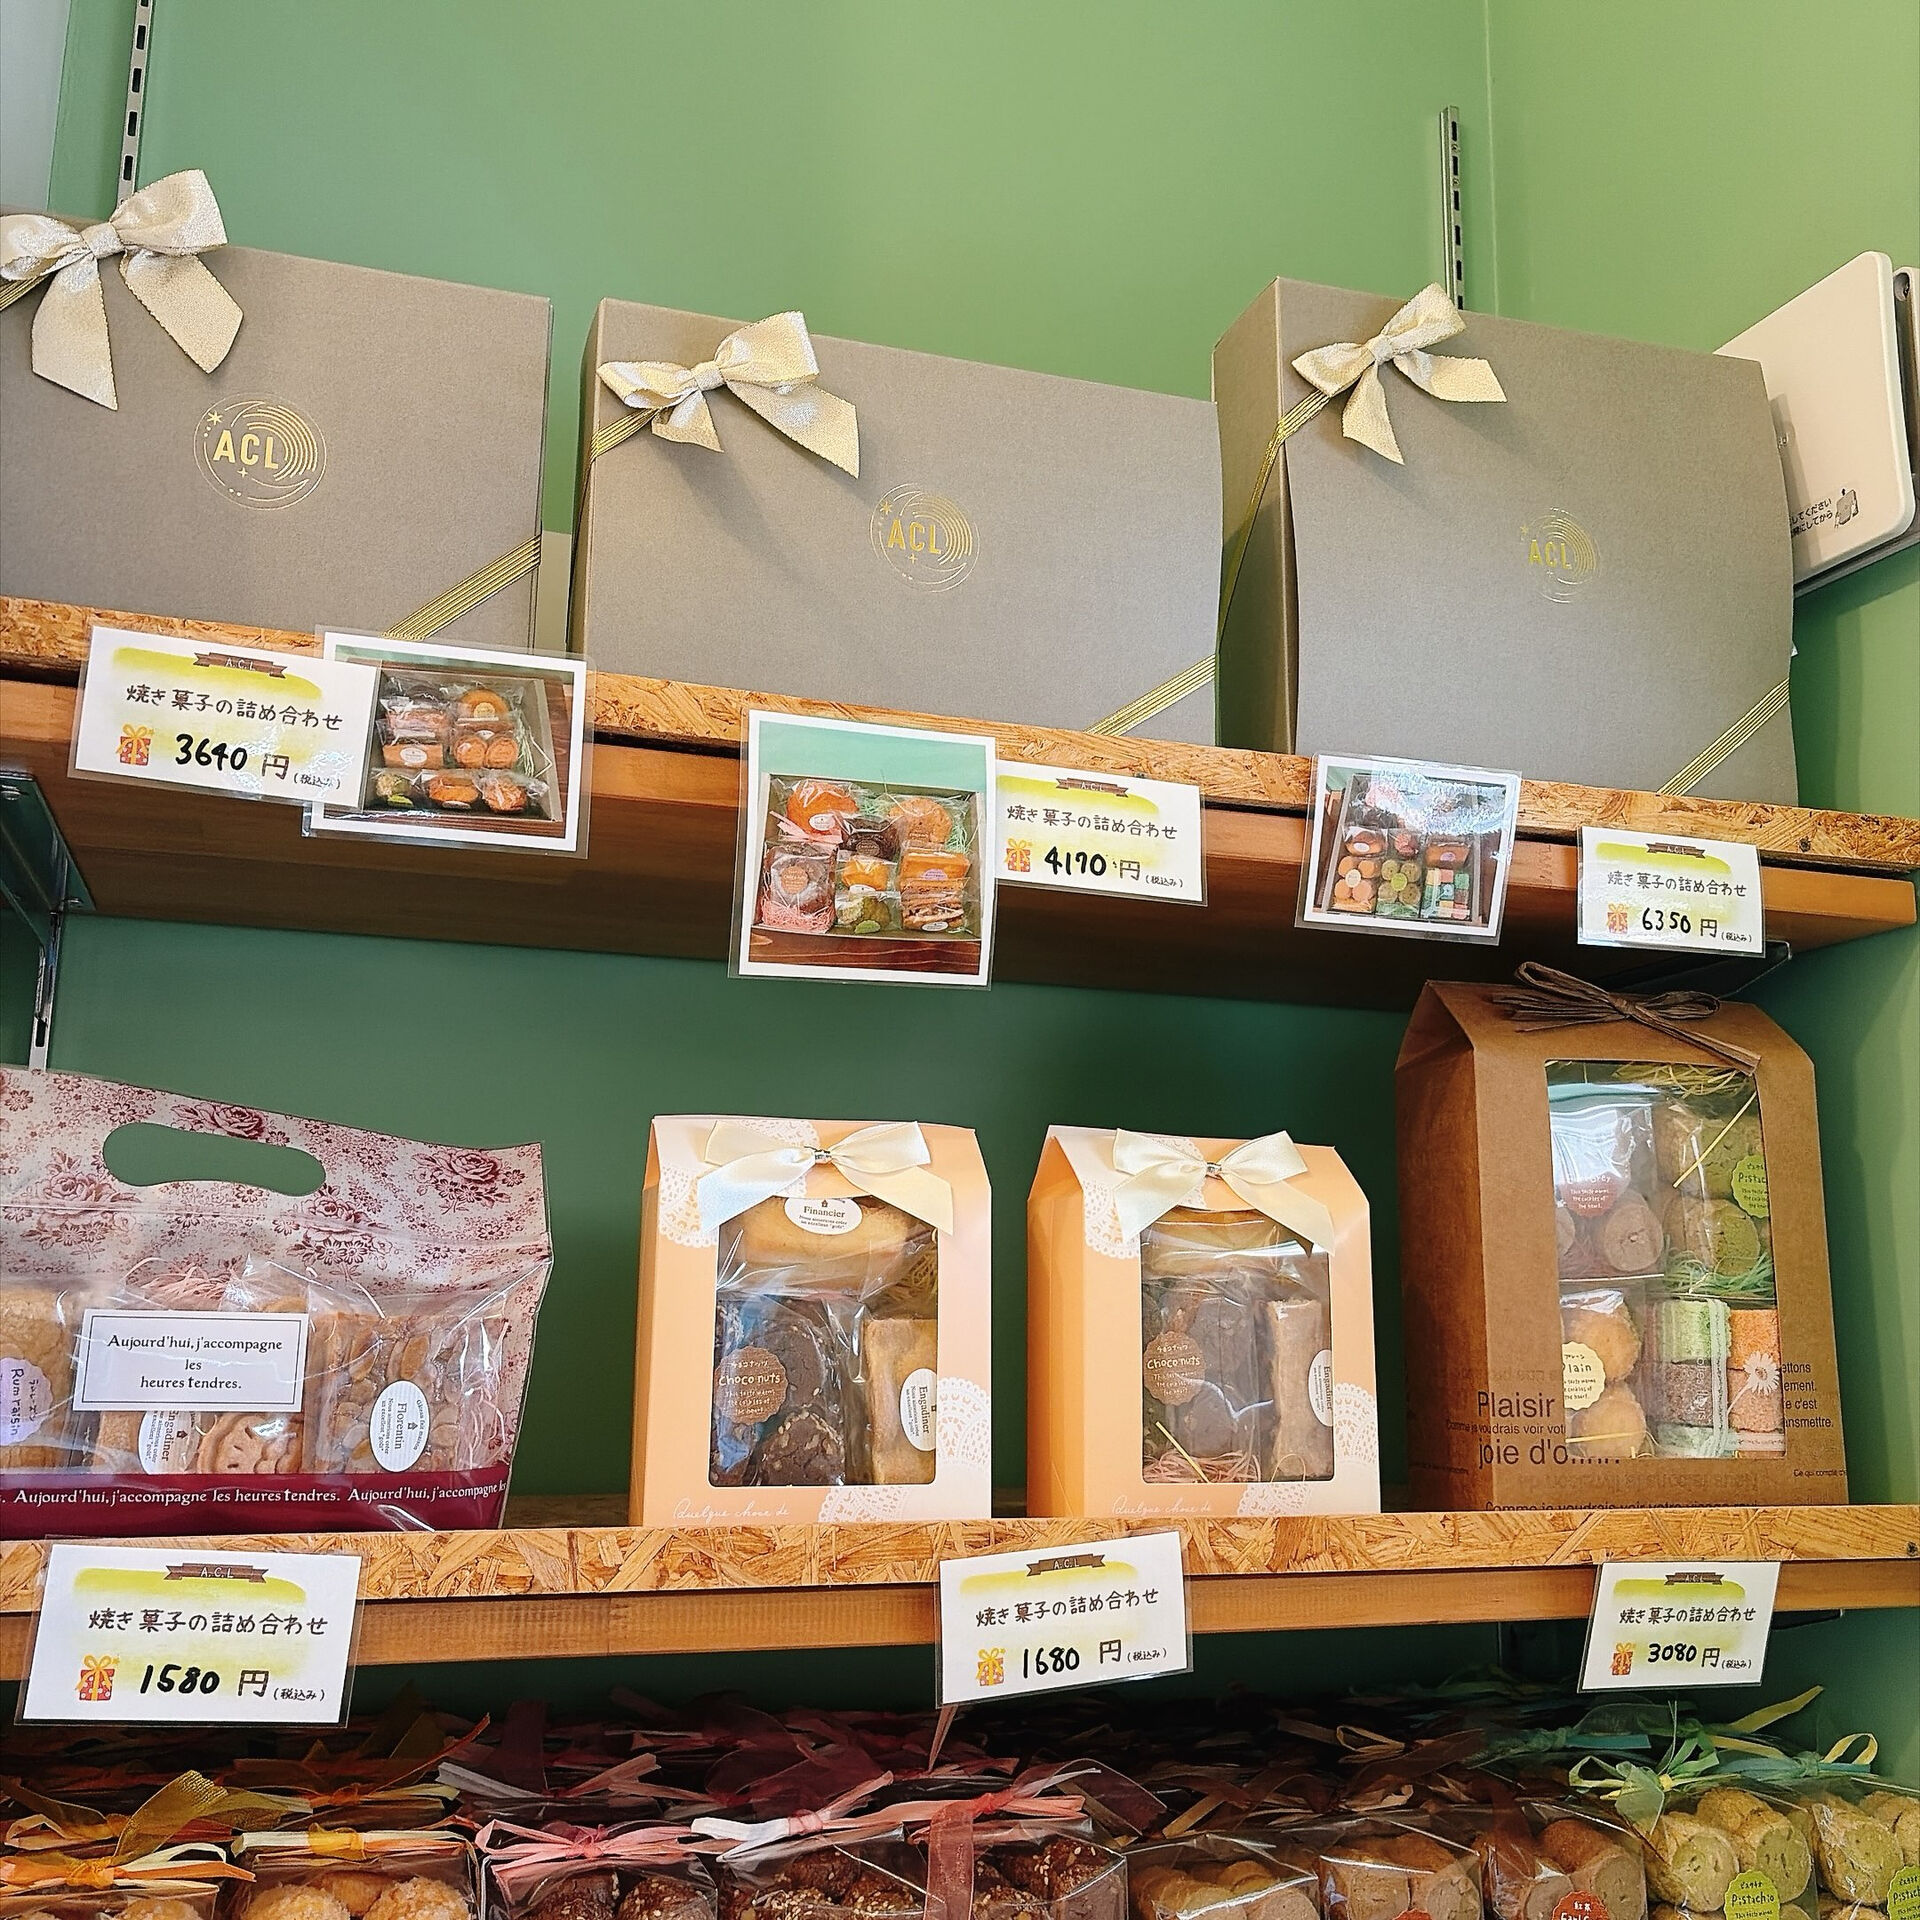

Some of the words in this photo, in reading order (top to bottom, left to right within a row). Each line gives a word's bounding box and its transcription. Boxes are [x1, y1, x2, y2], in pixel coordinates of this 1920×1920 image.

[213, 429, 279, 470] ACL
[888, 518, 942, 556] ACL
[1528, 539, 1573, 570] ACL
[174, 733, 248, 771] 3640
[261, 753, 290, 780] 円
[1044, 846, 1108, 876] 4170
[1119, 859, 1141, 881] 円
[1642, 907, 1692, 934] 6350
[1700, 918, 1718, 938] 円
[803, 1205, 846, 1218] Financier
[185, 1359, 202, 1370] les
[1147, 1359, 1179, 1369] Choco
[1180, 1355, 1201, 1366] nuts
[11, 1368, 25, 1396] Rum
[140, 1376, 185, 1388] heures
[188, 1376, 242, 1389] tendres.
[718, 1375, 755, 1386] Choco
[757, 1372, 781, 1384] nuts
[918, 1386, 930, 1434] Engadiner
[1477, 1391, 1555, 1418] Plaisir
[1795, 1398, 1818, 1410] c'est
[394, 1402, 408, 1450] Florentin
[1479, 1423, 1520, 1434] voudrais
[1523, 1424, 1544, 1434] voir
[1479, 1438, 1519, 1470] joie
[110, 1489, 207, 1507] j'accompagne
[212, 1489, 231, 1502] les
[234, 1488, 281, 1502] heures
[283, 1488, 341, 1502] tendres.
[1022, 1646, 1080, 1678] 1680
[1099, 1639, 1122, 1664] 円
[1647, 1643, 1697, 1664] 3080
[1701, 1647, 1721, 1668] 円
[140, 1663, 220, 1694] 1580
[237, 1669, 270, 1697] 円
[1731, 1891, 1775, 1907] Pistachio
